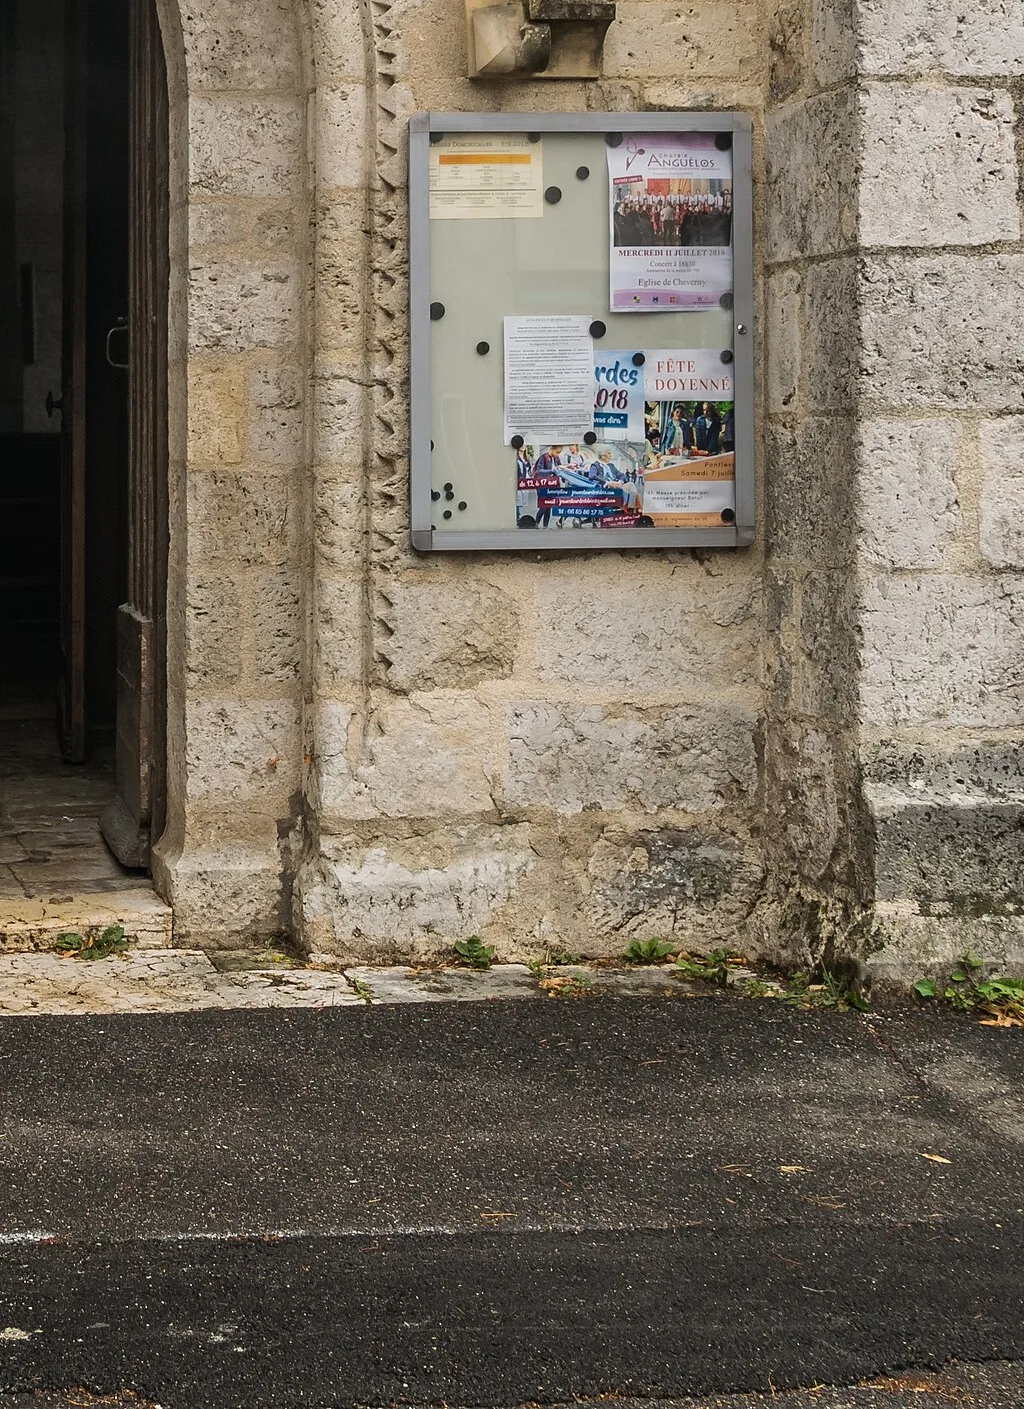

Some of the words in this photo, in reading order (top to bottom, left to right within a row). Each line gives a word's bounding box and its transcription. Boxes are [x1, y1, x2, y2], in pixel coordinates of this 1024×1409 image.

[647, 153, 715, 168] ANGUÉLOS
[618, 249, 663, 257] MERCREDI
[665, 249, 672, 257] 11
[674, 249, 707, 257] JUILLET
[662, 278, 672, 286] de
[672, 278, 707, 288] Cheverny
[594, 360, 638, 386] rdes
[657, 358, 696, 373] FÊTE
[655, 376, 730, 391] DOYENNÉ
[594, 388, 629, 410] 018
